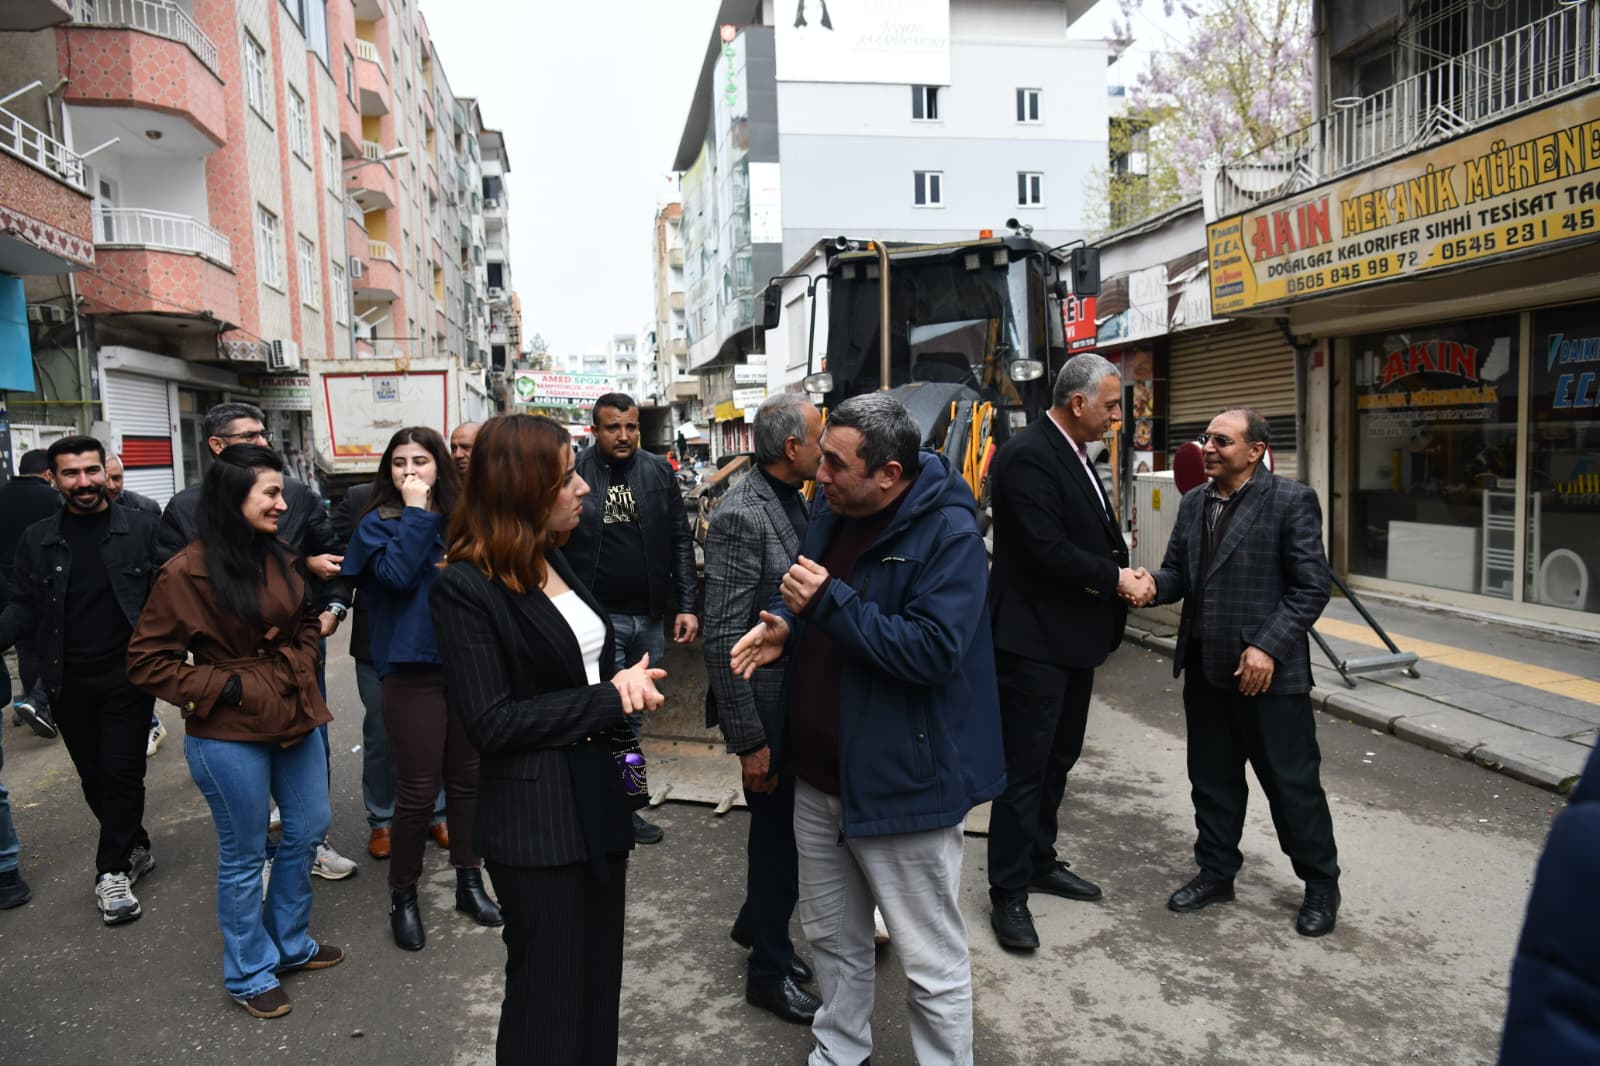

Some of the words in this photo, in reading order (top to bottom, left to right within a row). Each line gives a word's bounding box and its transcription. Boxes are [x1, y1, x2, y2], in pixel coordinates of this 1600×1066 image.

[1251, 196, 1333, 263] AKIN
[1341, 163, 1459, 239] MEKANİK
[1268, 250, 1333, 278] DOĞALGAZ
[1426, 211, 1472, 240] SIHHİ
[1478, 191, 1557, 226] TESİSAT
[1565, 181, 1600, 205] TA
[1287, 272, 1324, 293] 0505
[1397, 251, 1418, 269] 72
[1442, 232, 1496, 260] 0545
[1506, 219, 1548, 246] 231
[1562, 209, 1595, 231] 45
[542, 375, 572, 383] AMED
[1380, 340, 1479, 389] AKIN
